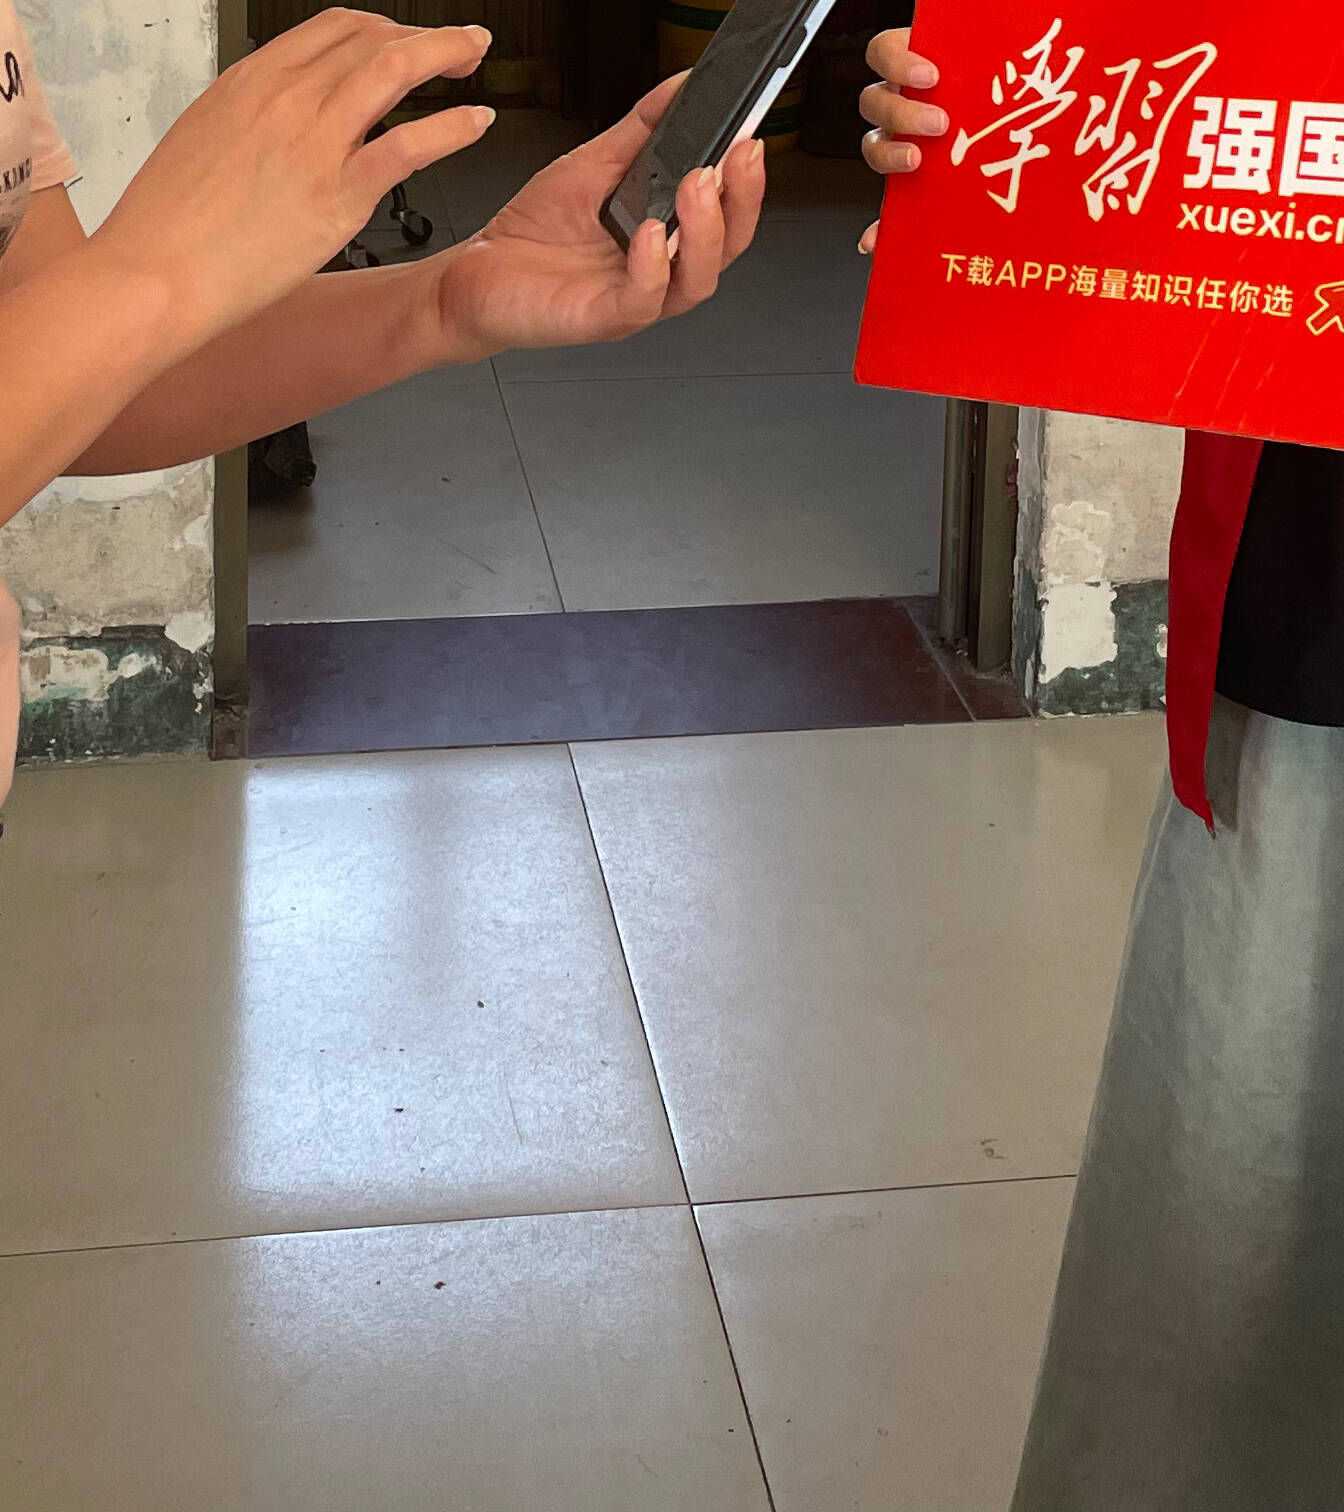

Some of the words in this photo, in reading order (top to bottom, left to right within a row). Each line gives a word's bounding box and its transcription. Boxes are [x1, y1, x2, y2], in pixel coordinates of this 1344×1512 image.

[940, 252, 1295, 318] 下载APP海量知识任你选
